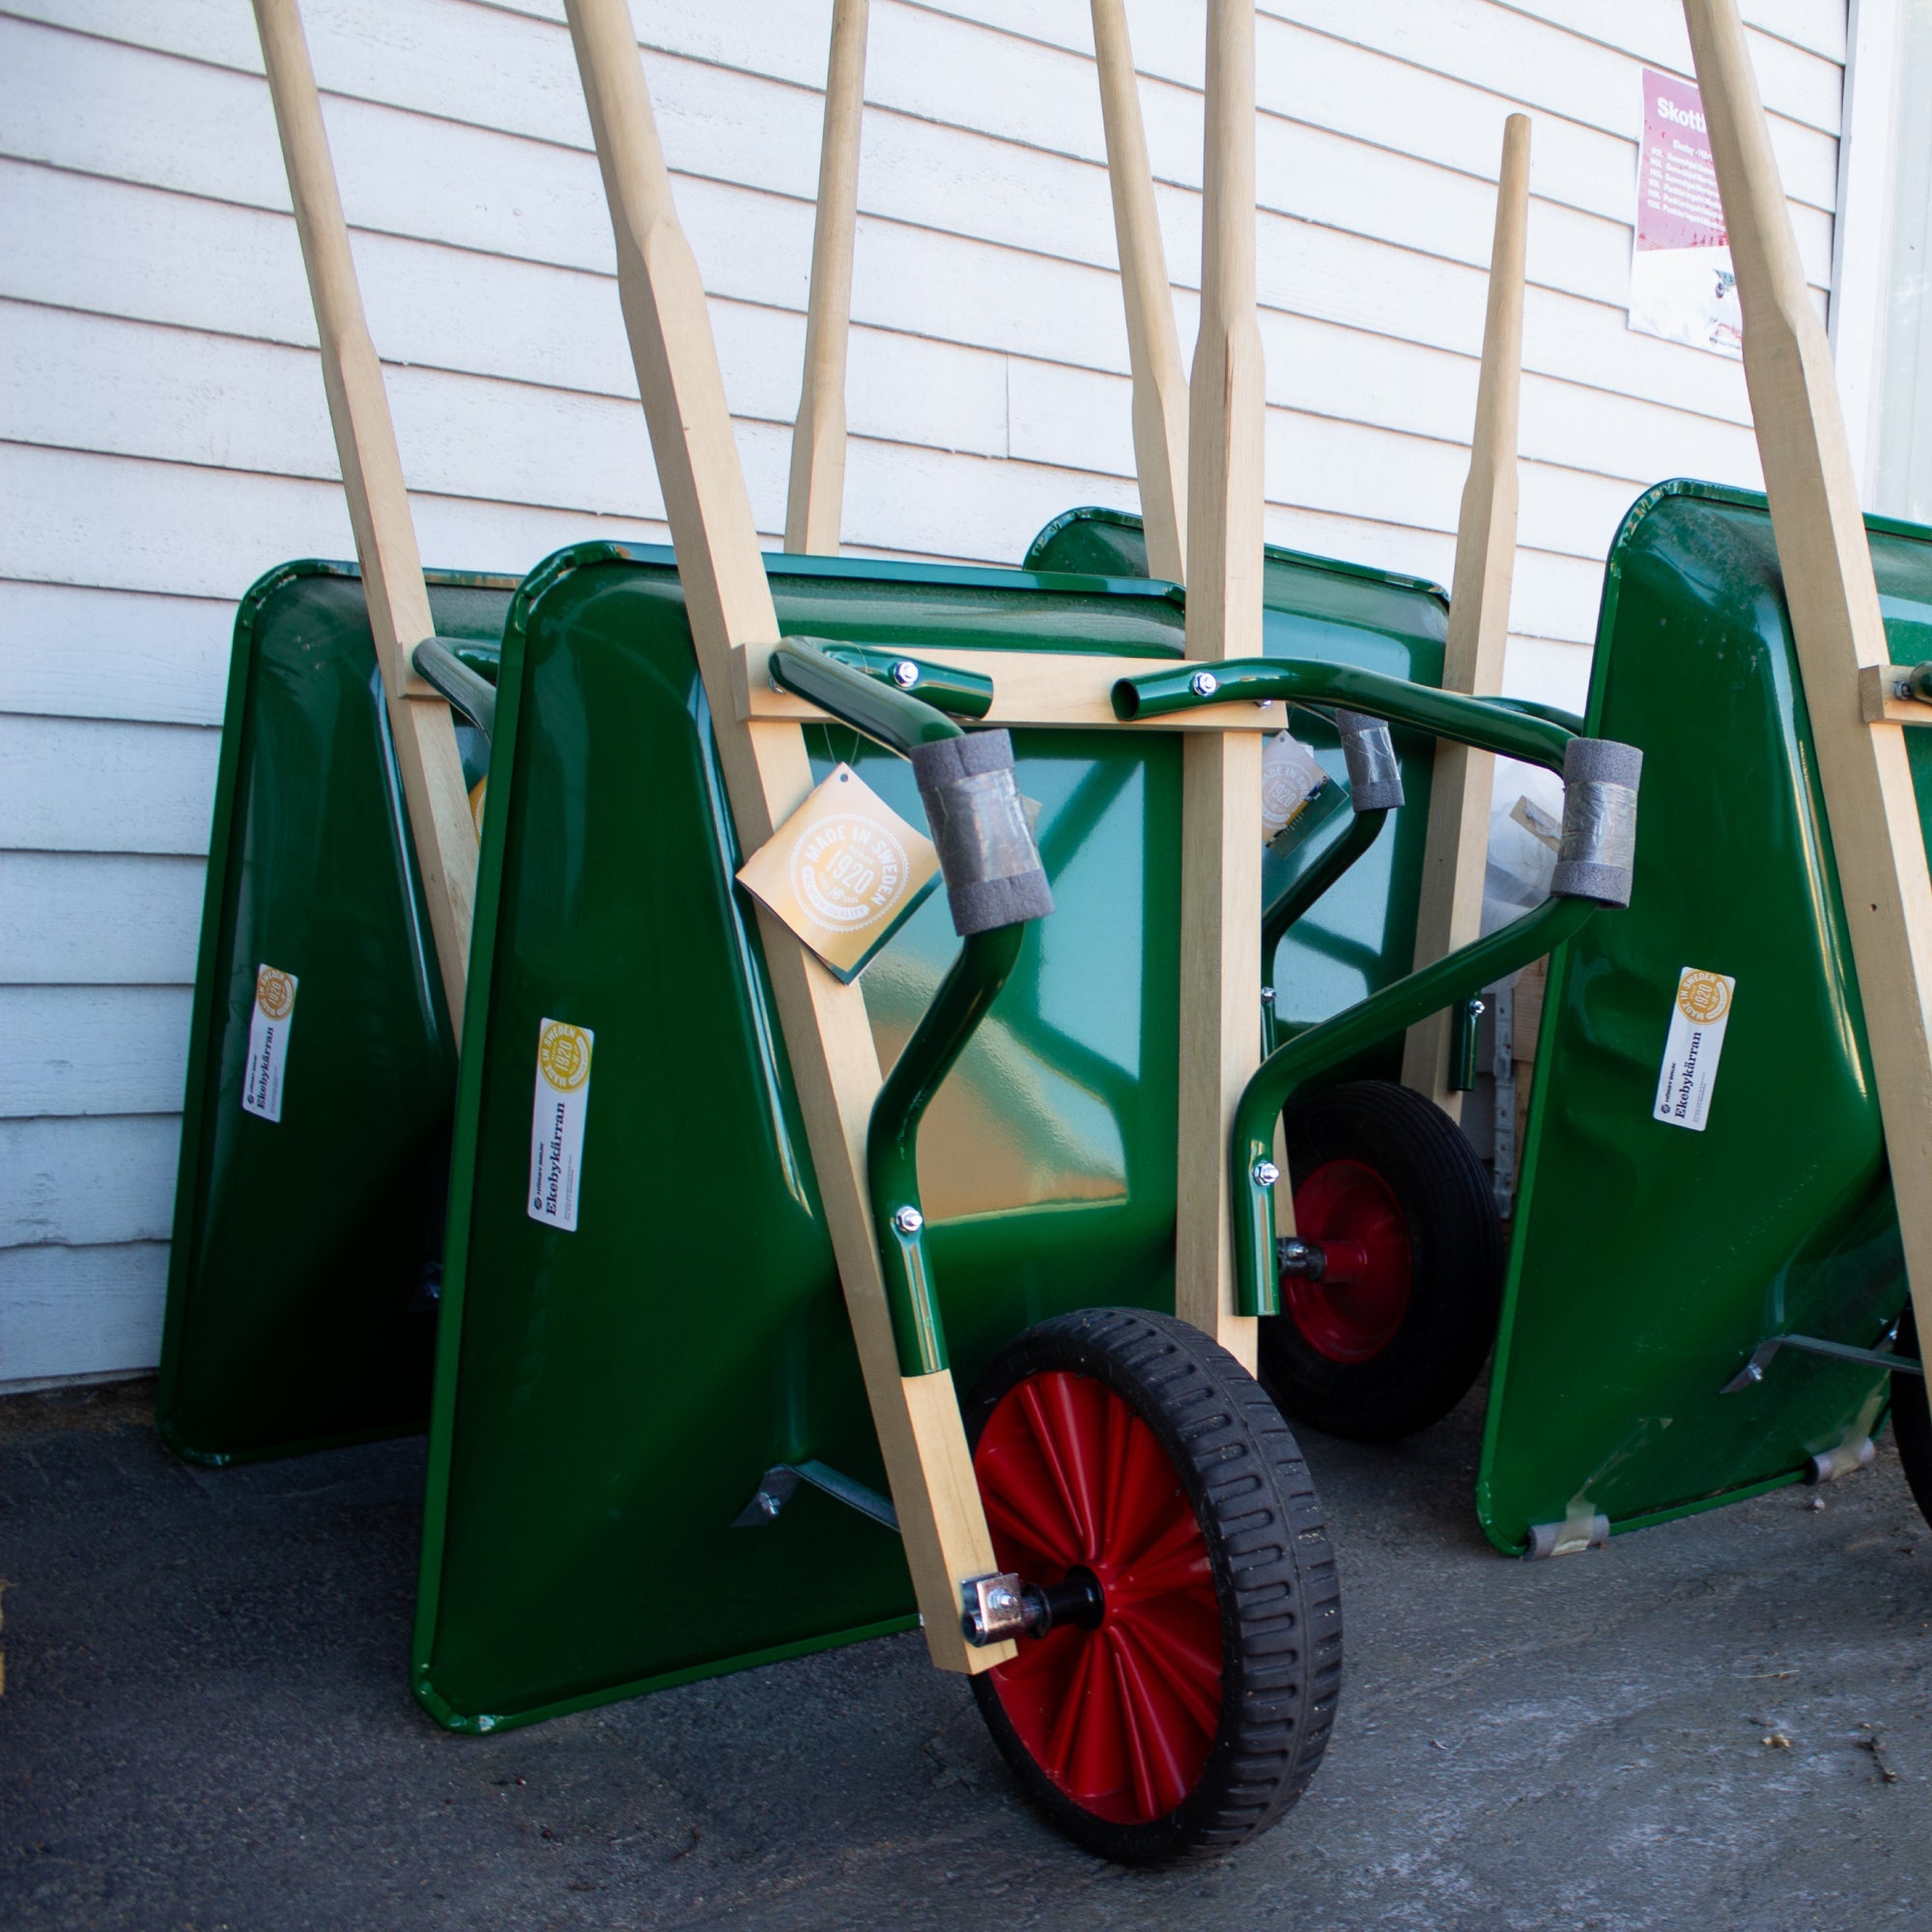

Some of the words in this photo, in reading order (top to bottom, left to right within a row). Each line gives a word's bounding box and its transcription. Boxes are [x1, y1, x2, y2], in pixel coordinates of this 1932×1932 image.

[1267, 781, 1296, 808] 1920
[805, 826, 846, 862] MADE
[853, 827, 870, 845] IN
[871, 840, 897, 906] SWEDEN
[826, 850, 874, 895] 1920
[1683, 972, 1718, 989] SWEDEN
[1680, 990, 1689, 1001] IN
[1694, 984, 1713, 1008] 1920
[1682, 999, 1704, 1020] MADE
[543, 1024, 576, 1050] SWEDEN
[257, 1027, 274, 1111] Ekebykärran
[542, 1050, 552, 1062] IN
[555, 1039, 573, 1072] 1920
[1674, 1032, 1702, 1120] Ekebykärran
[546, 1102, 566, 1216] Ekebykärran
